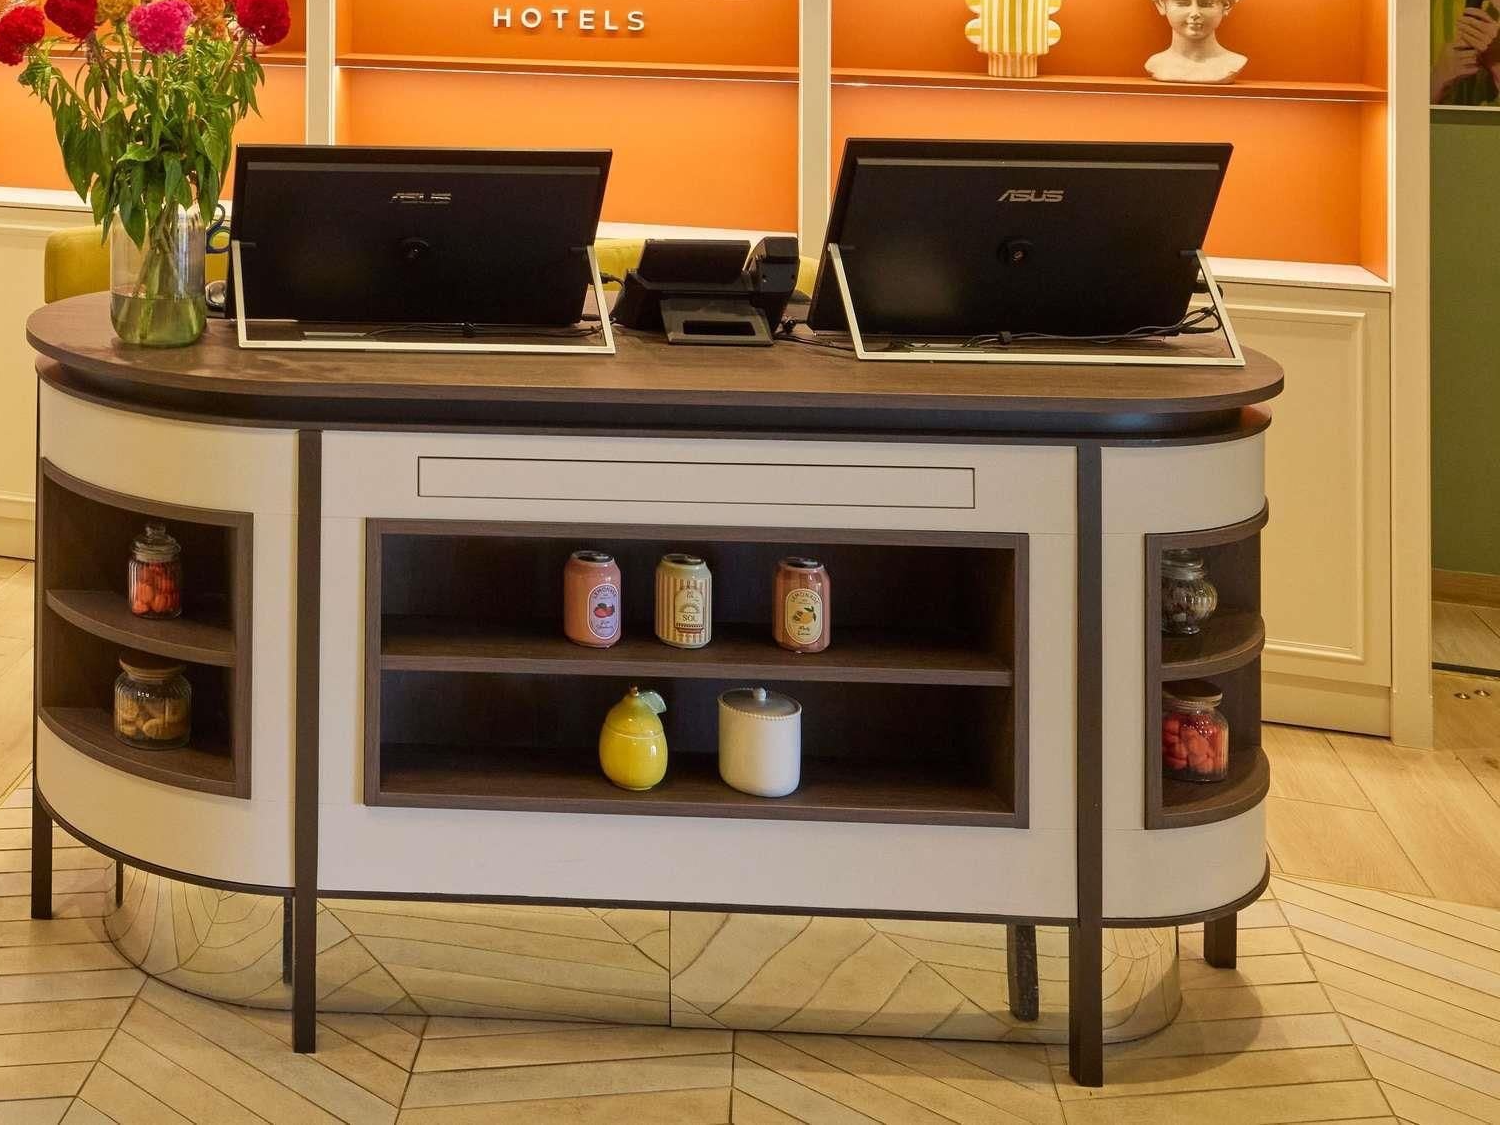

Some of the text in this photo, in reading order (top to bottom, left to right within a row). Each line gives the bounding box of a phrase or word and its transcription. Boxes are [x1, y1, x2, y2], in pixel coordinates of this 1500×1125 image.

[492, 7, 646, 32] HOTELS
[998, 189, 1064, 203] ASUS
[682, 614, 698, 622] SOL
